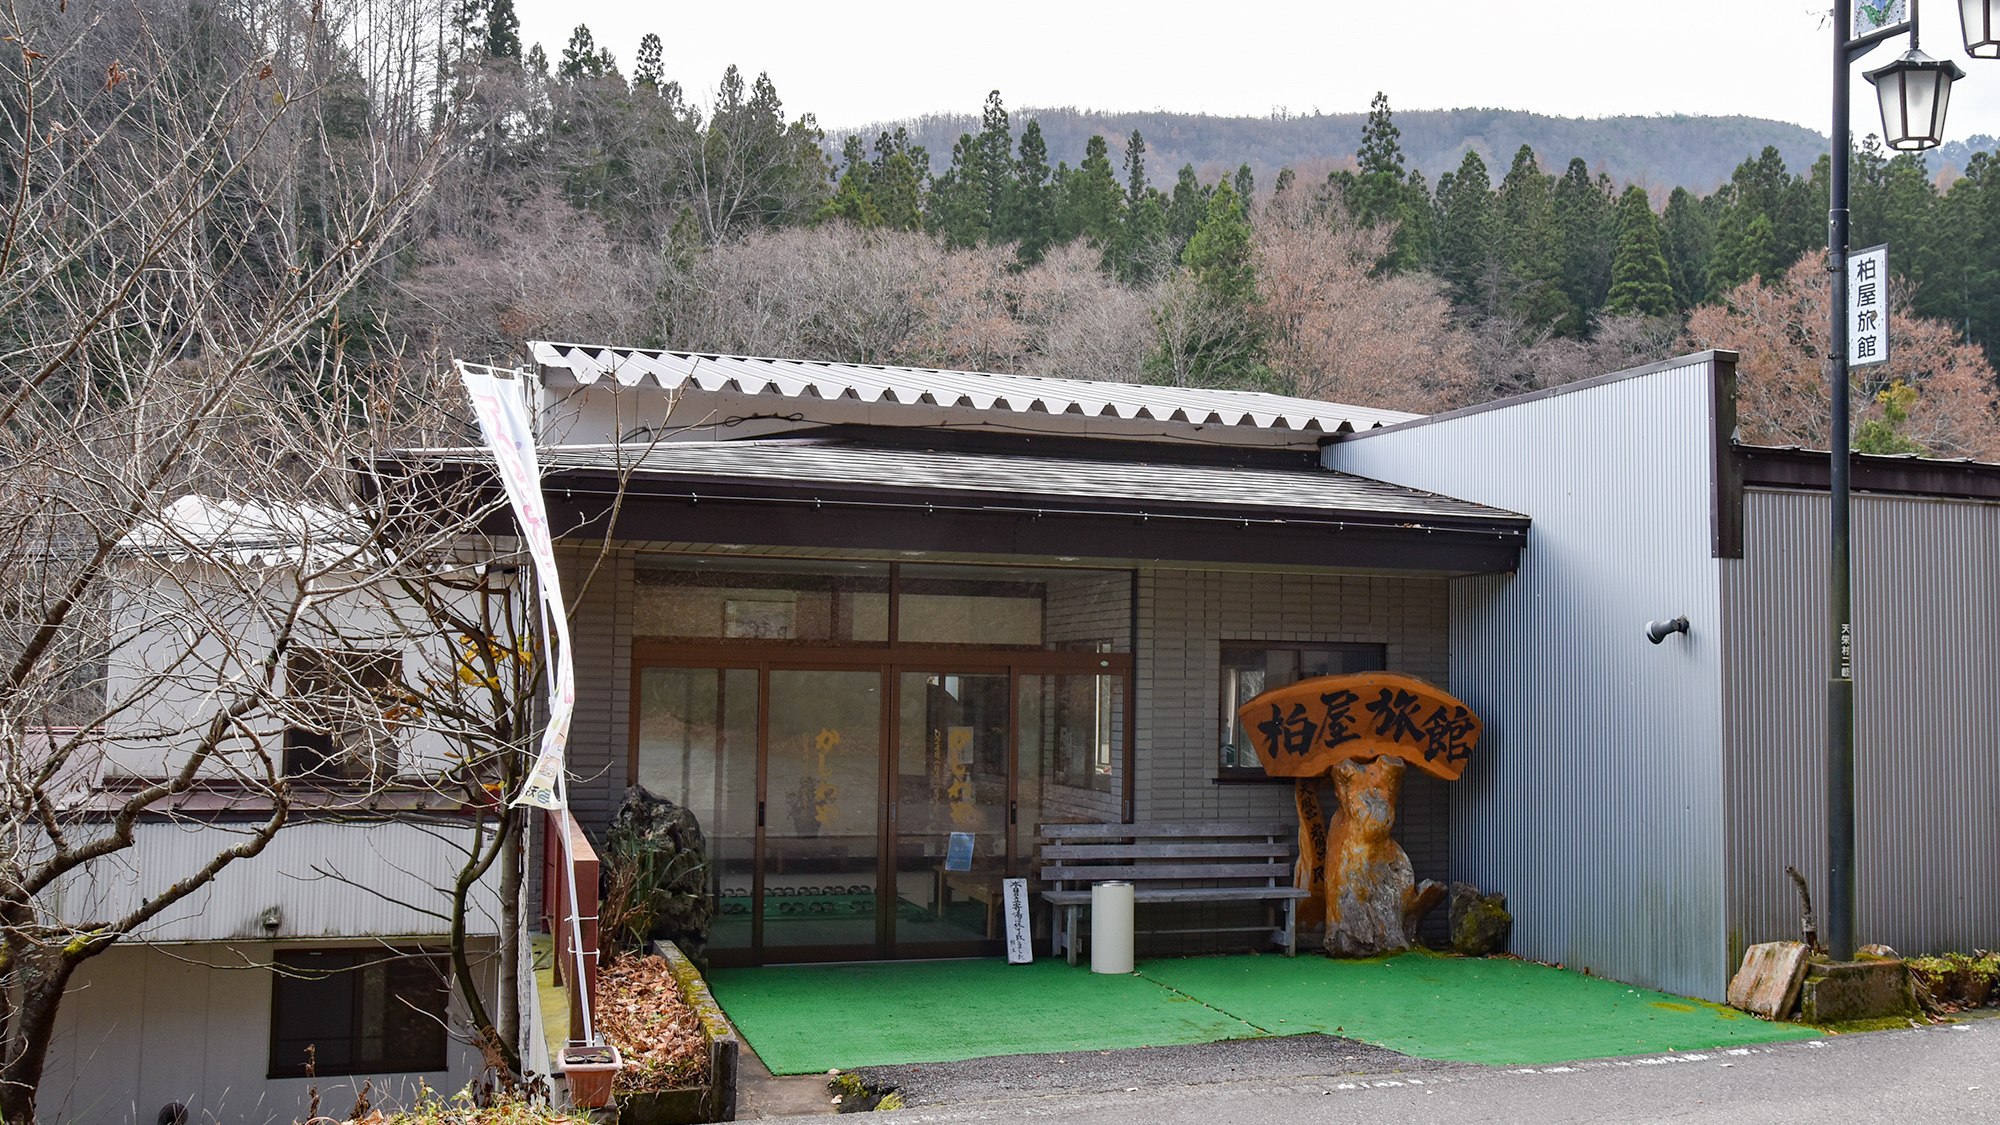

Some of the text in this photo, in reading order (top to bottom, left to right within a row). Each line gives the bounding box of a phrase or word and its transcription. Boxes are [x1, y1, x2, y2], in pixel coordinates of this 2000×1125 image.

[1857, 257, 1877, 359] 柏屋旅館
[1257, 687, 1476, 764] 柏屋旅館
[813, 727, 840, 827] かしわや
[947, 727, 973, 824] かしわや
